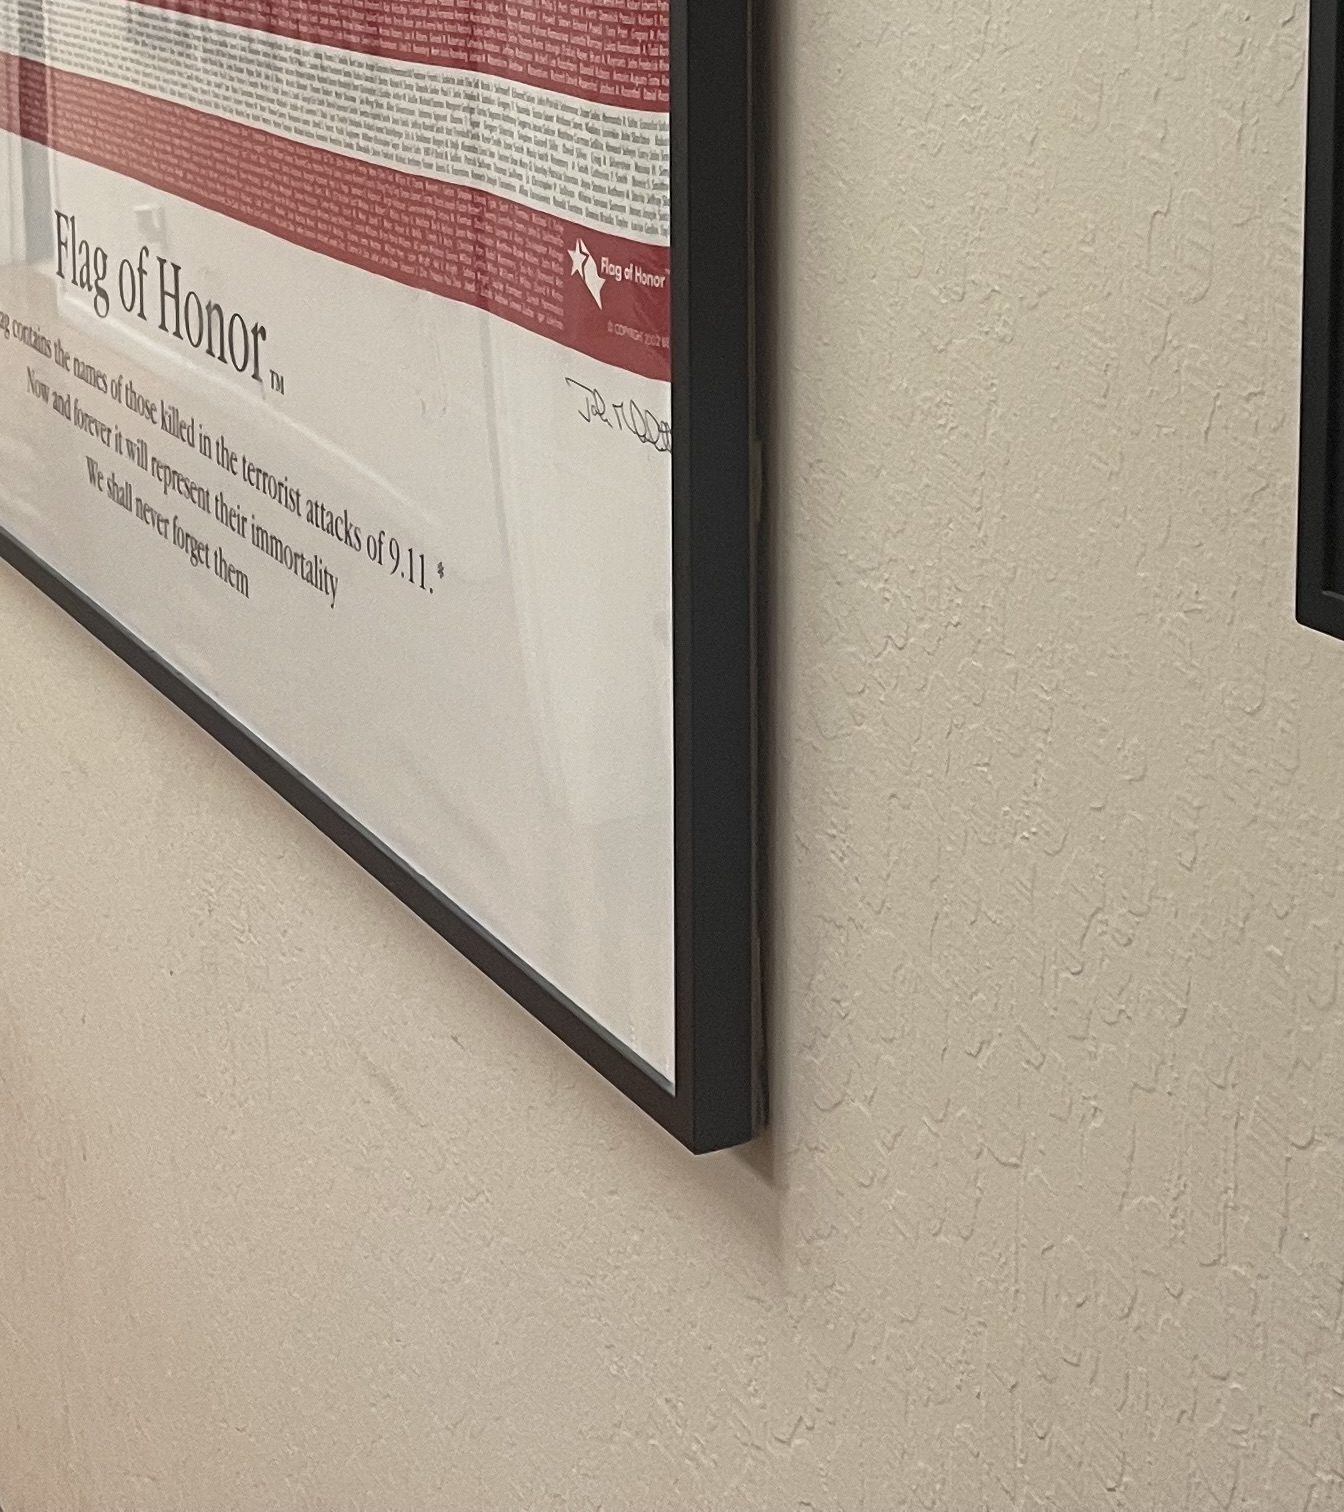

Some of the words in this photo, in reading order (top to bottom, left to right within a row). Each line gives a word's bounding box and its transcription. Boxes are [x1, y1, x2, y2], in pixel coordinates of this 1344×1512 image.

[54, 209, 110, 318] Flag
[118, 245, 150, 322] of
[156, 255, 267, 383] Honor
[601, 257, 623, 282] Flag
[635, 265, 666, 288] Honor
[12, 319, 52, 359] contains
[54, 338, 71, 372] the
[73, 357, 108, 394] names
[110, 374, 123, 404] of
[125, 380, 158, 425] those
[160, 399, 196, 448] killed
[199, 423, 213, 460] in
[215, 434, 238, 476] the
[242, 454, 302, 517] terrorist
[306, 499, 362, 552] attacks
[366, 530, 386, 566] of
[26, 366, 50, 404] Now
[52, 390, 72, 421] and
[73, 397, 112, 448] forever
[114, 423, 124, 456] it
[125, 437, 149, 472] will
[151, 456, 212, 515] represent
[214, 491, 248, 539] their
[251, 513, 339, 609] immortality
[86, 455, 104, 493] We
[106, 472, 133, 513] shall
[135, 497, 170, 540] never
[172, 514, 211, 568] forget
[213, 546, 250, 600] them
